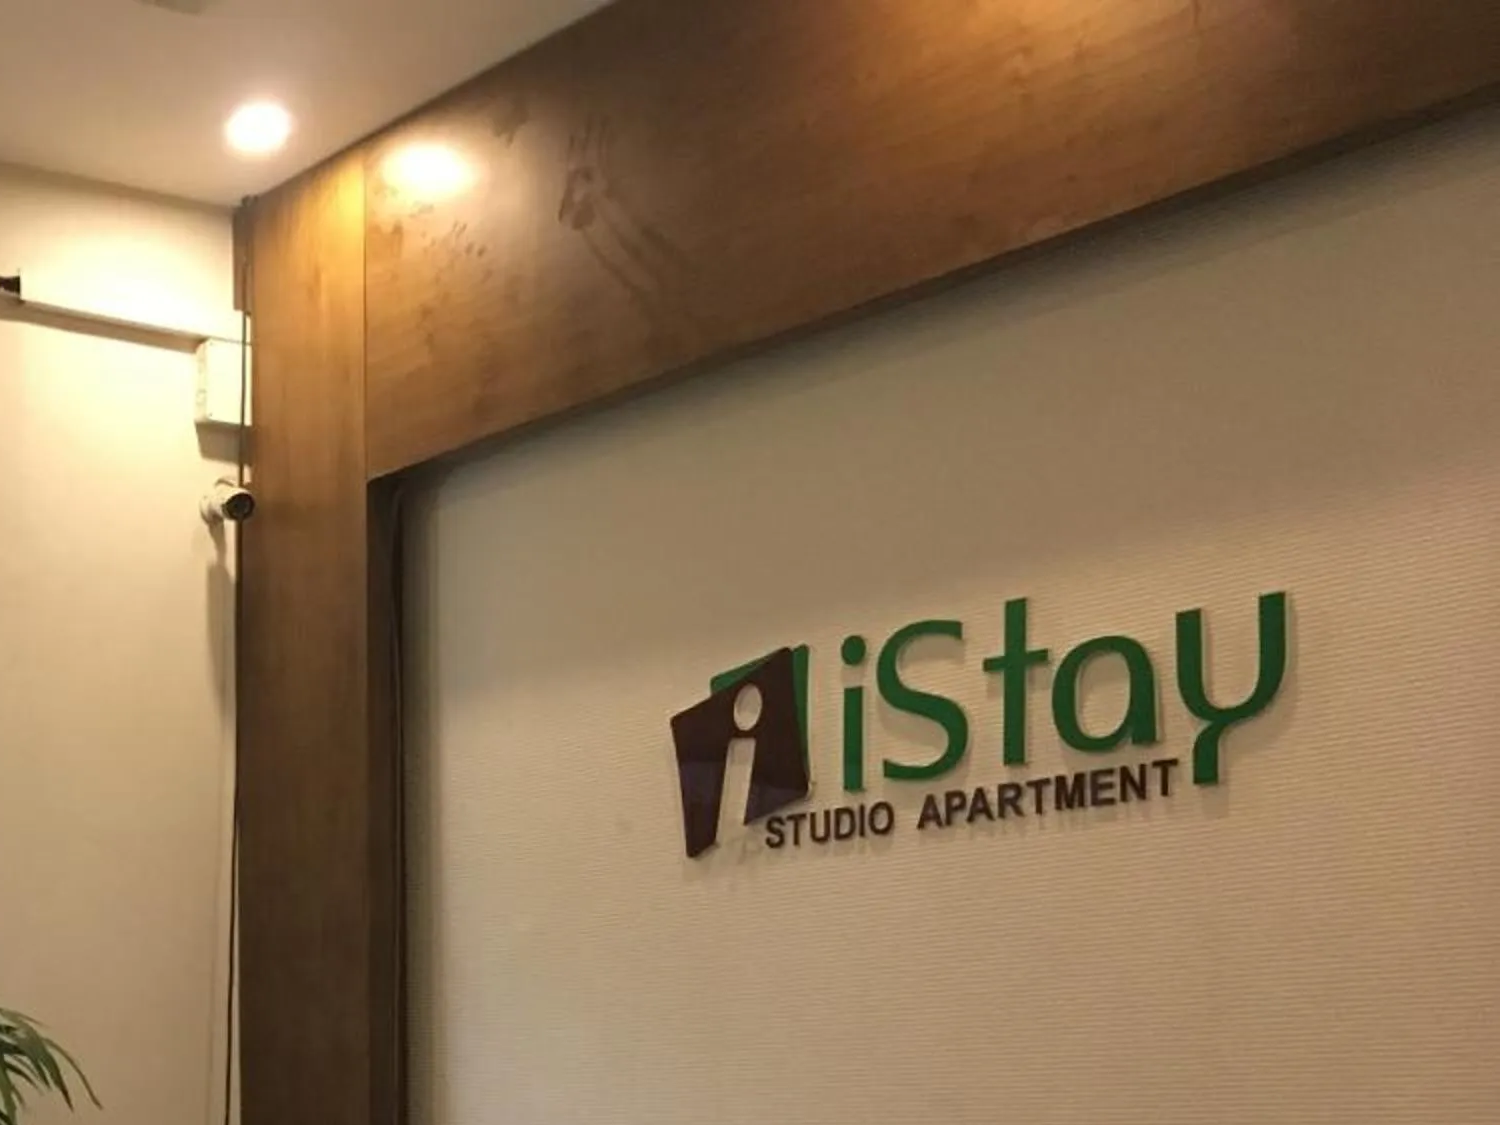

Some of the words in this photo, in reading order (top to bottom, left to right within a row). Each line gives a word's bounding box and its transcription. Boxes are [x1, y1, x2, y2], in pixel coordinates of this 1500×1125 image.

[841, 591, 1286, 792] iStay
[765, 801, 895, 849] STUDIO
[917, 758, 1180, 829] APARTMENT
